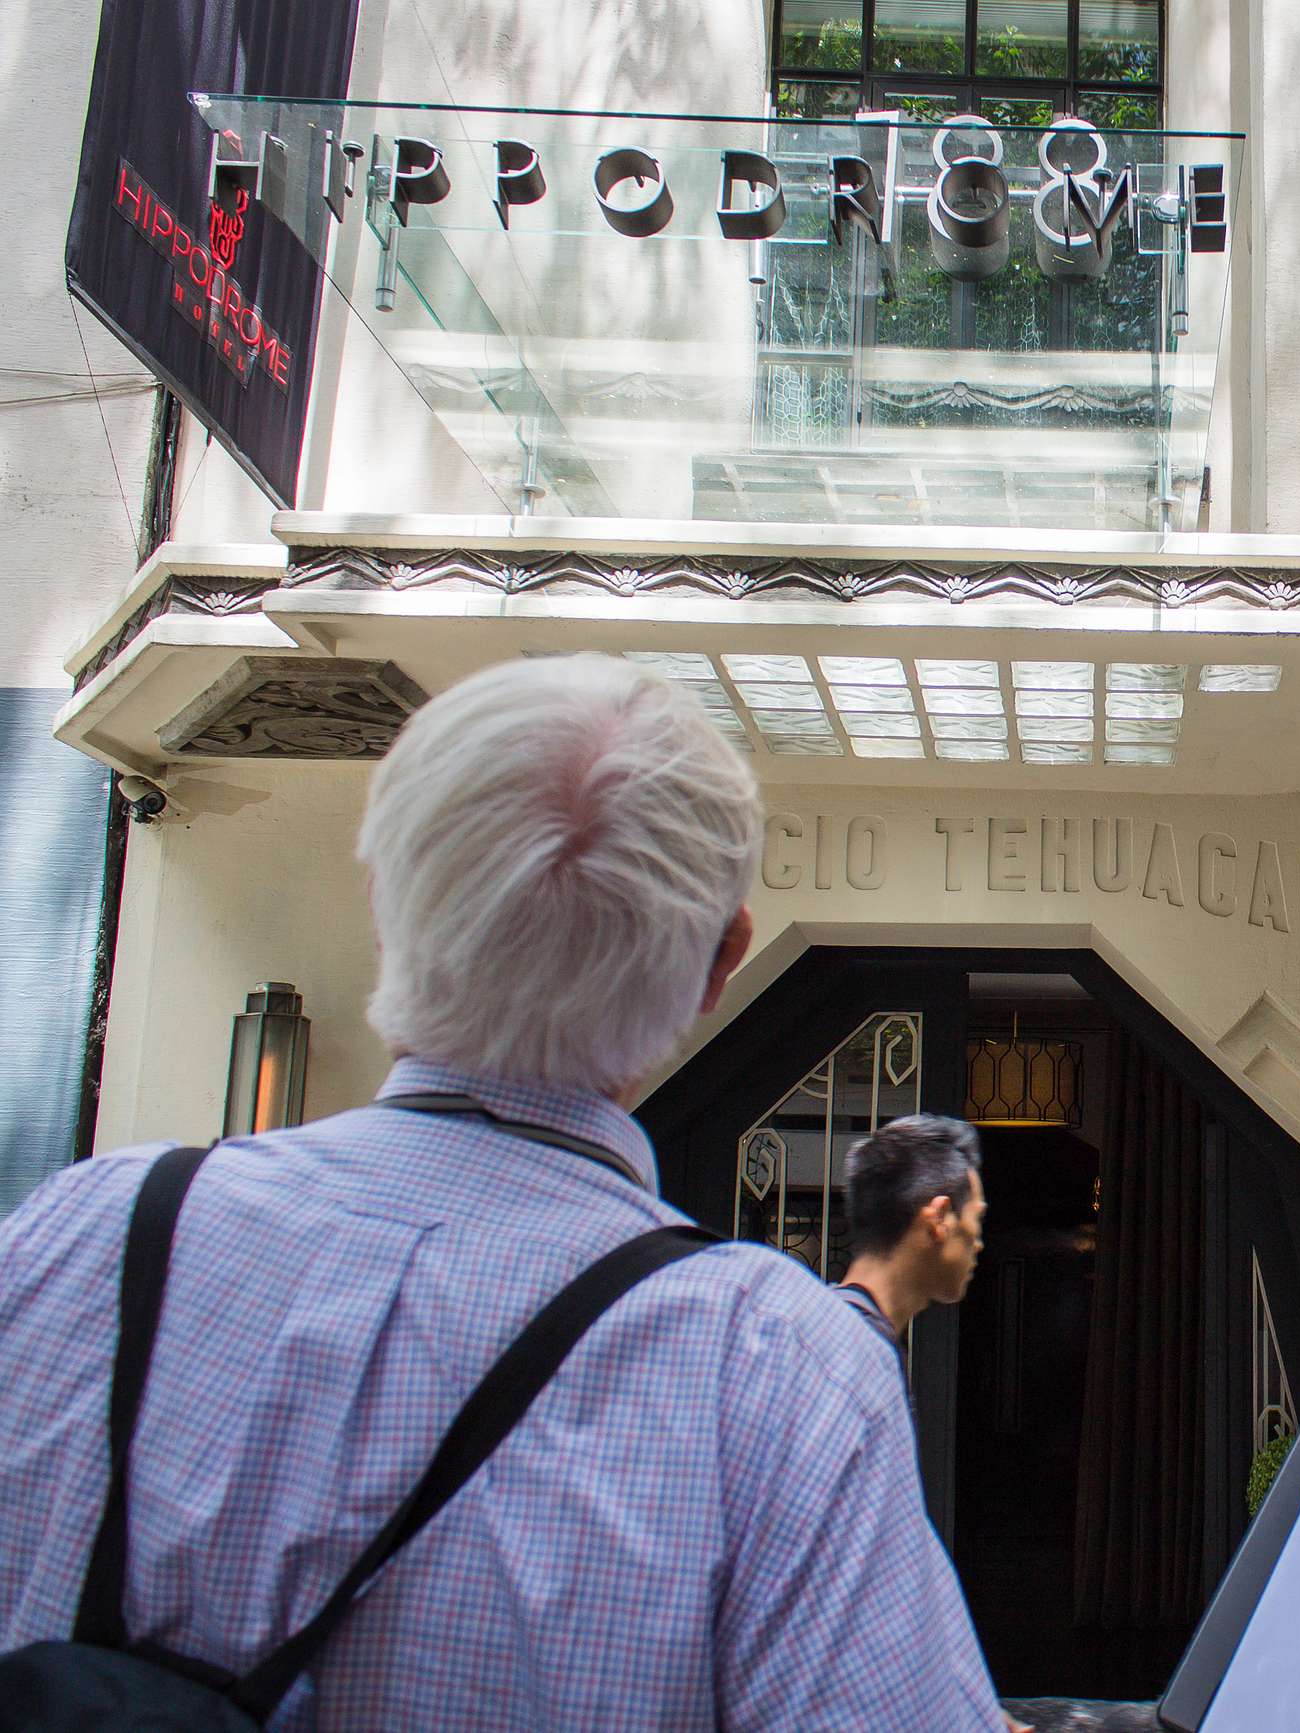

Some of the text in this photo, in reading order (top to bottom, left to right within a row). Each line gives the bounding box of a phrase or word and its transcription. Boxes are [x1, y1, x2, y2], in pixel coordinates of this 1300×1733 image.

[207, 129, 1227, 254] HIPPODROME
[117, 167, 290, 386] HIPPODROME
[174, 282, 246, 373] HOTEL
